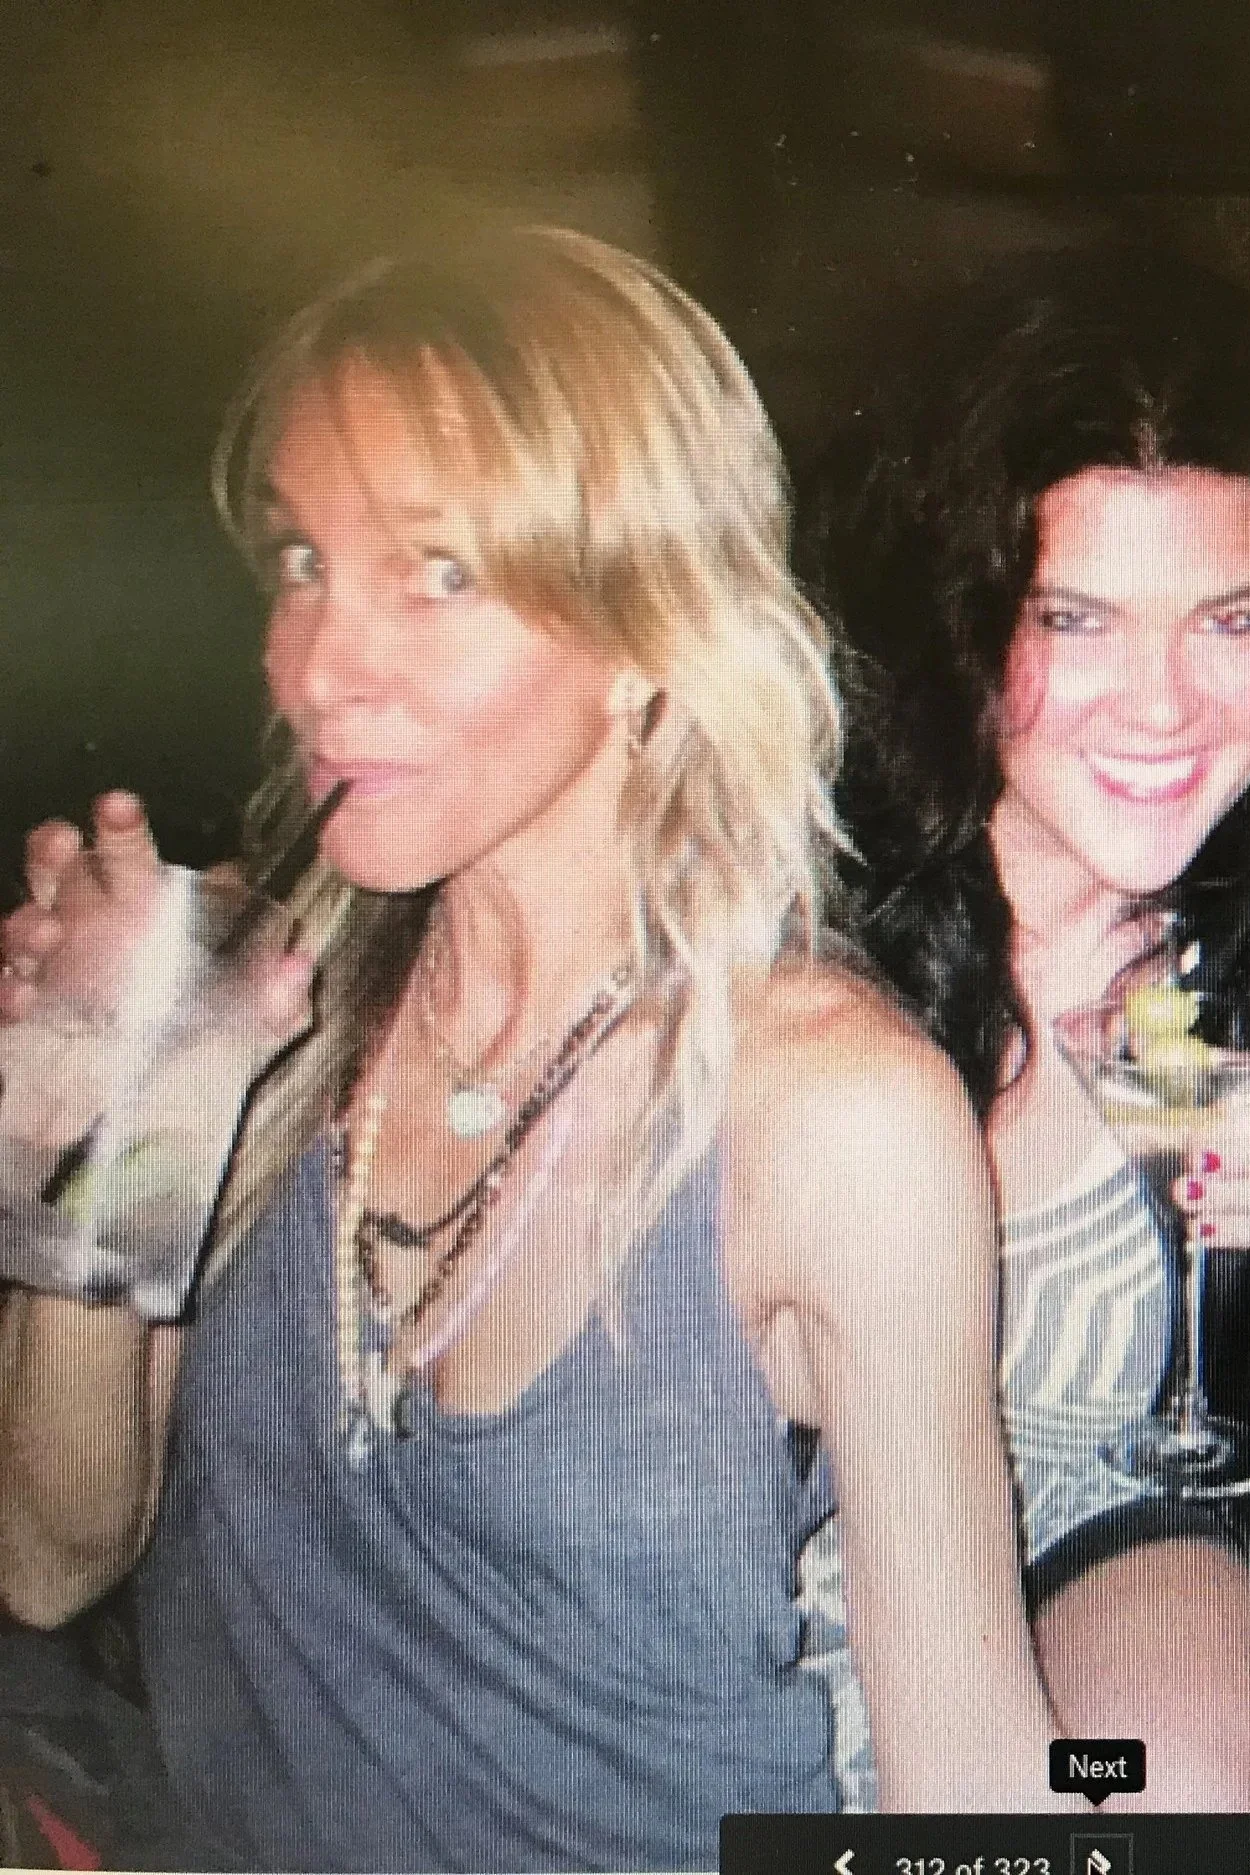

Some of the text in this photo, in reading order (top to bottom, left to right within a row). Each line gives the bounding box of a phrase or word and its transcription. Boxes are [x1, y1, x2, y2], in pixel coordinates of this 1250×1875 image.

[1069, 1754, 1128, 1778] Next
[895, 1855, 1051, 1875] 312 of 323
